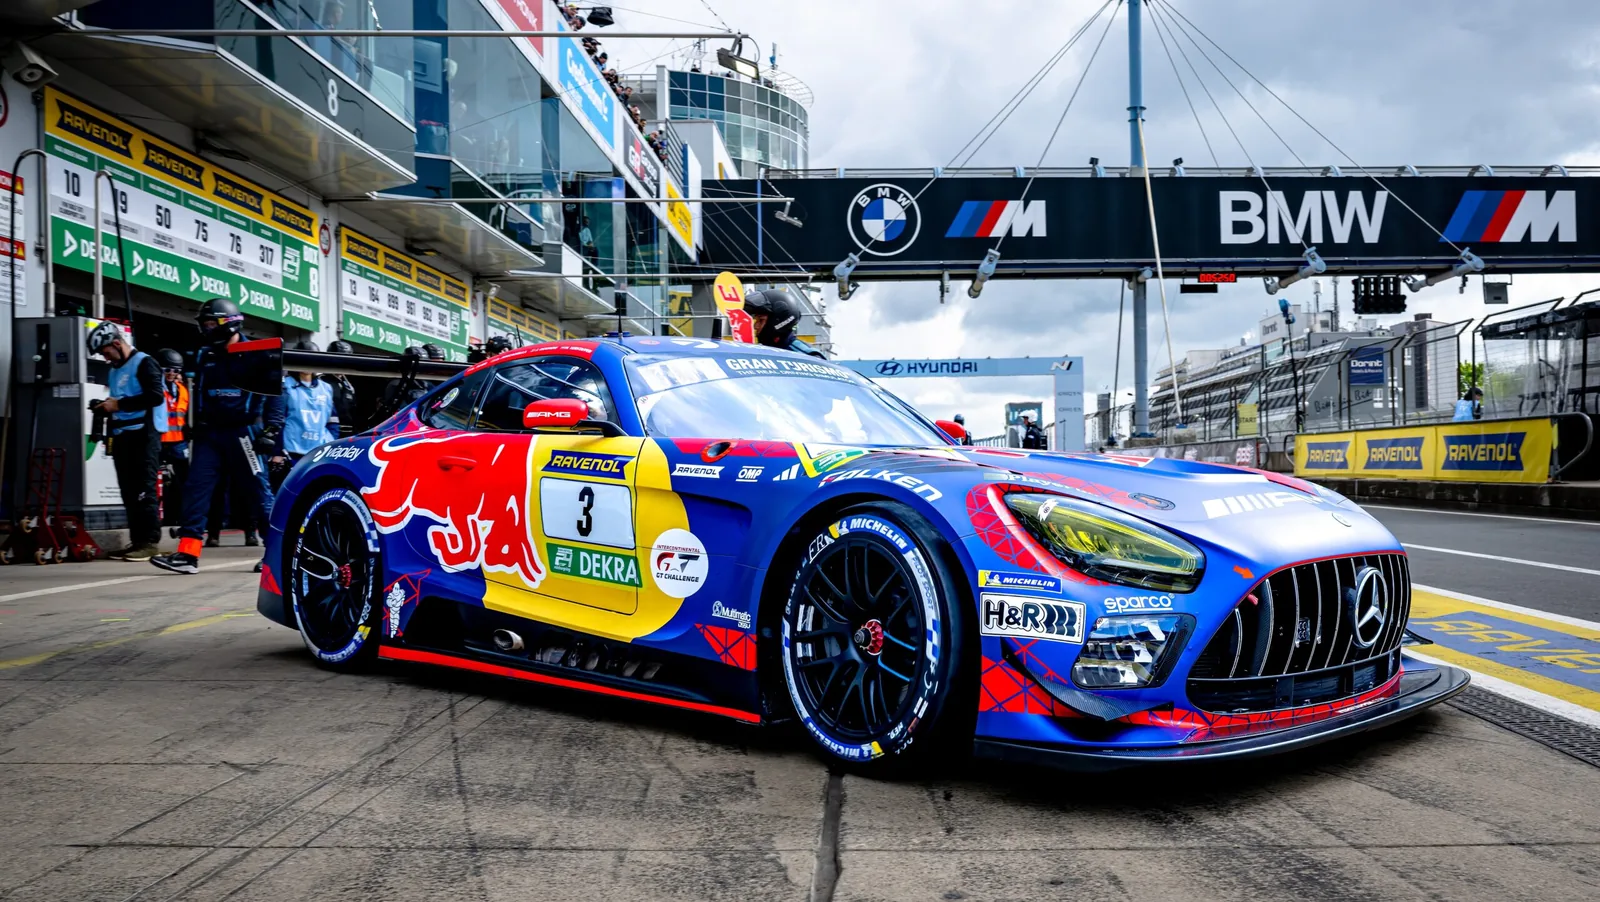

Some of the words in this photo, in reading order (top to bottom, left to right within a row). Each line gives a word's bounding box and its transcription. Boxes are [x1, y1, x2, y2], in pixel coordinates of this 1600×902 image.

[327, 78, 339, 117] 8
[63, 111, 127, 149] RAVENOL
[148, 149, 200, 182] RAVENOL
[216, 181, 261, 209] RAVENOL
[274, 206, 312, 231] RAVENOL
[63, 169, 81, 197] 10
[155, 203, 171, 230] 50
[194, 219, 209, 243] 75
[229, 232, 242, 255] 76
[259, 244, 274, 266] 317
[1219, 190, 1388, 243] BMW
[81, 239, 121, 267] DERA
[147, 258, 180, 284] DEKRA
[202, 275, 232, 298] DEKRA
[249, 290, 275, 311] DEKRA
[291, 302, 314, 321] DEKRA
[309, 267, 319, 298] 8
[725, 358, 779, 370] GRAN
[907, 361, 978, 373] HYUNDAI
[301, 410, 321, 423] TV
[325, 445, 365, 461] viaplay
[551, 455, 620, 473] RAVENOL
[1309, 449, 1345, 462] RAVENOL
[1370, 447, 1419, 462] RAVENOL
[1449, 444, 1516, 461] RAVENOL
[676, 466, 717, 475] RAVENOL
[737, 468, 763, 480] OMP
[818, 469, 943, 502] FALKEN
[576, 486, 594, 537] 3
[850, 518, 908, 550] MICHELIN
[580, 551, 639, 585] DEKRA
[1003, 574, 1056, 587] MICHELIN
[983, 600, 1041, 632] H&R
[1104, 595, 1171, 613] sparco
